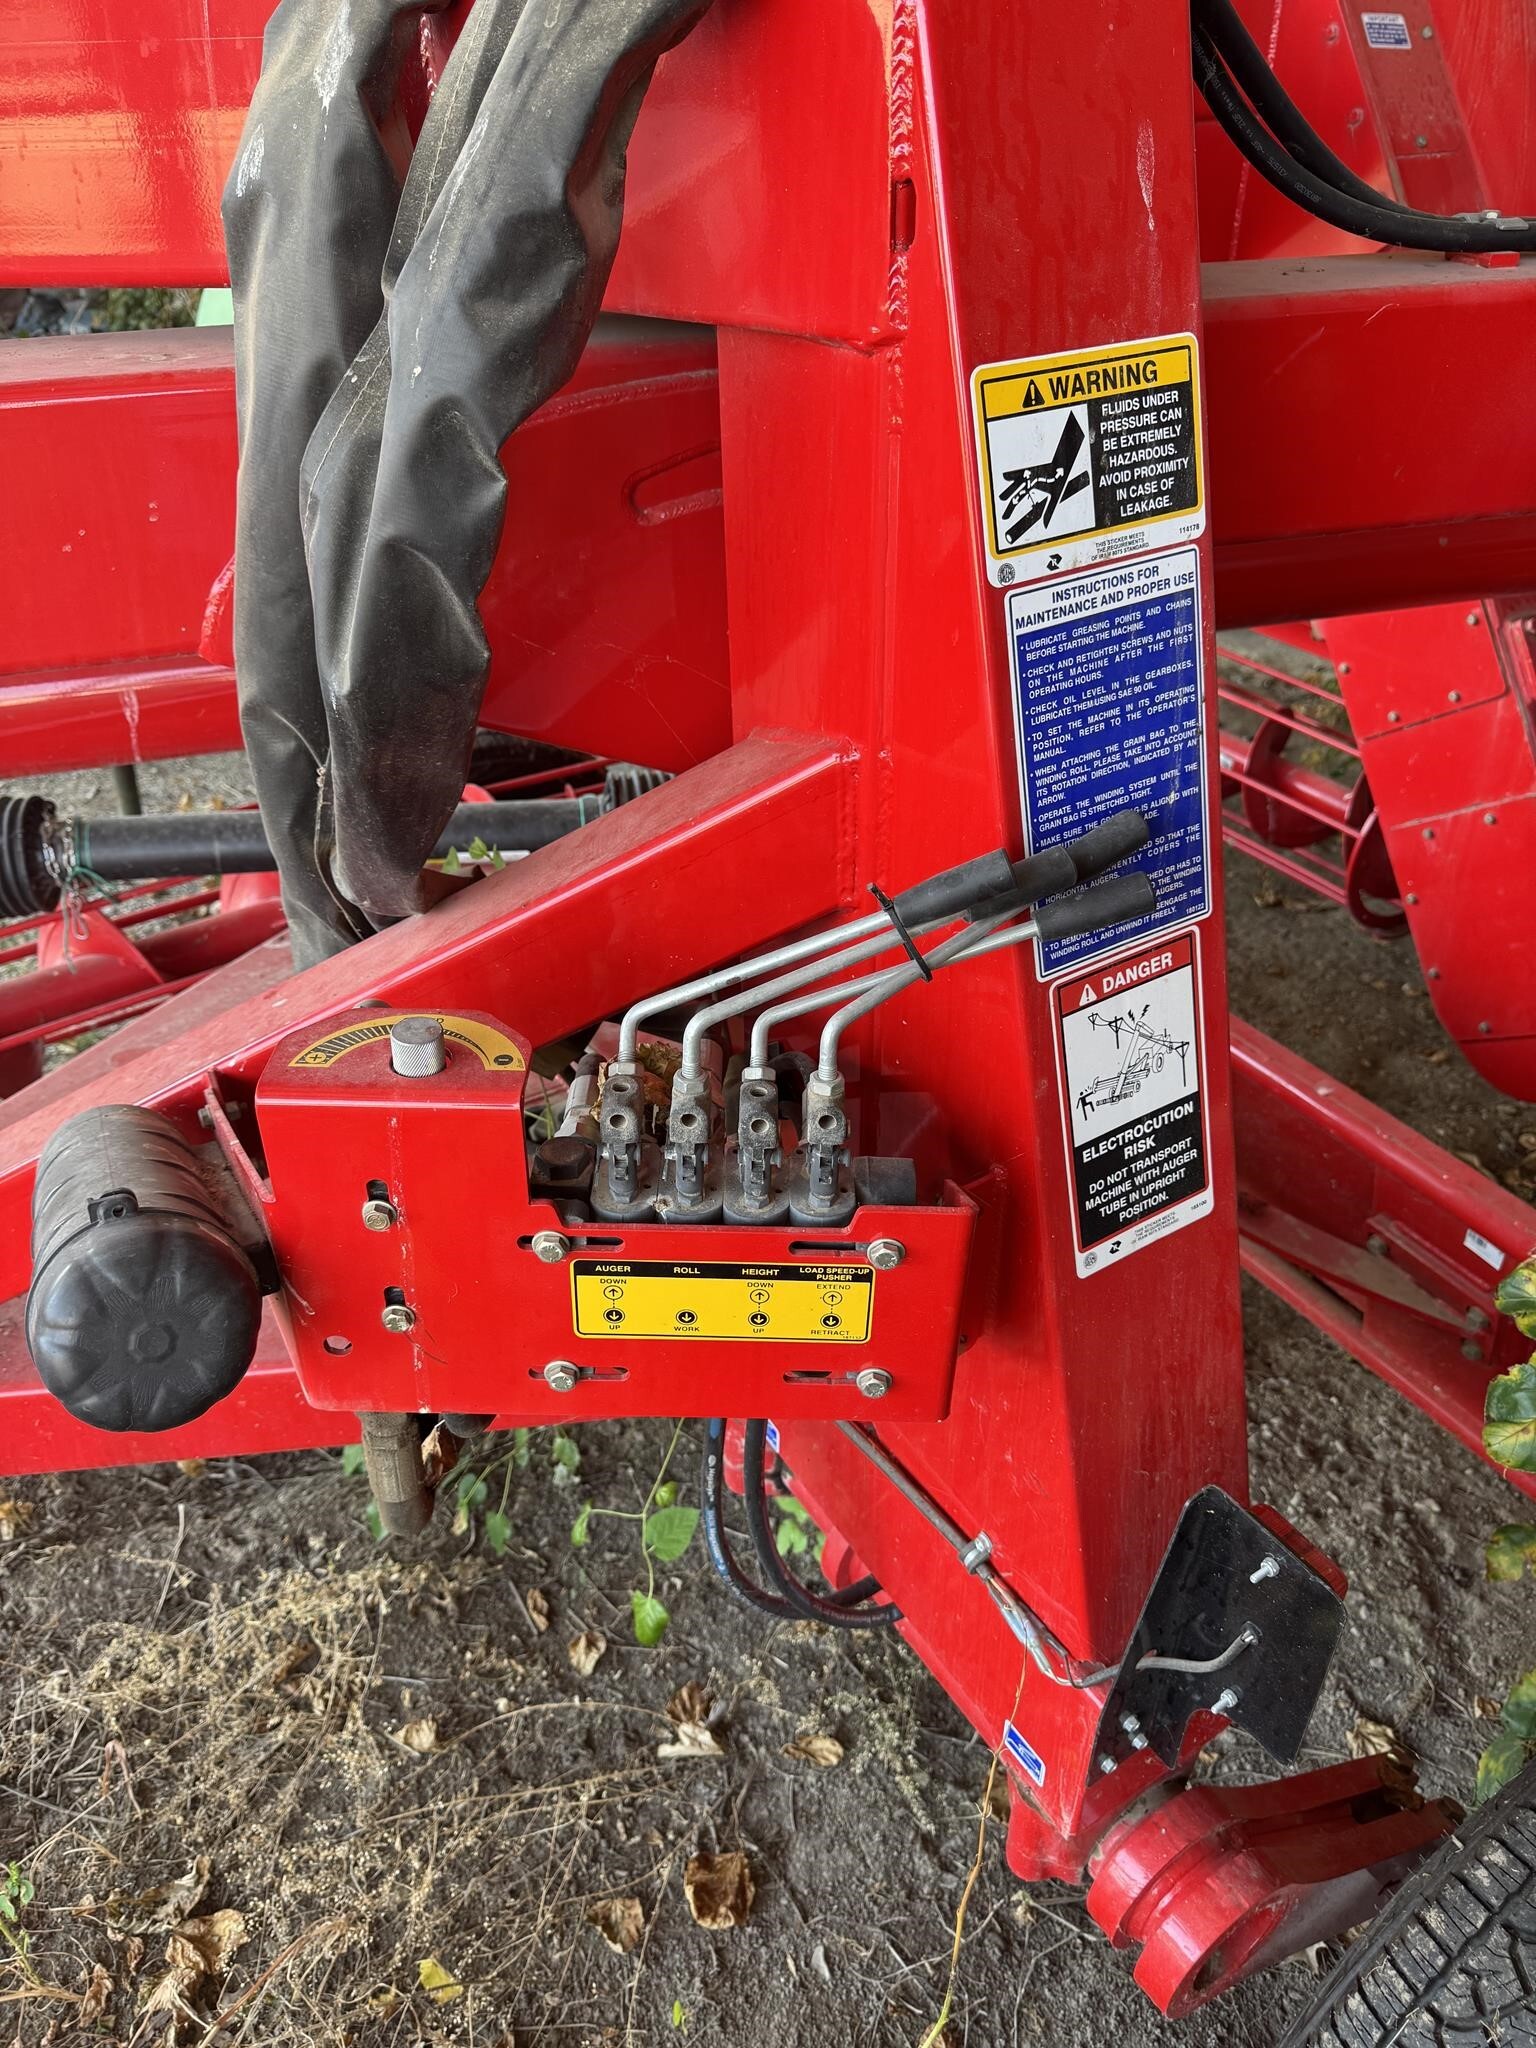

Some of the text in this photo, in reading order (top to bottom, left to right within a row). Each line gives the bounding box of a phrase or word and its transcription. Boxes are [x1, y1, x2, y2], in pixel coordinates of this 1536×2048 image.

[1049, 360, 1158, 401] WARNING
[1102, 391, 1179, 416] FLUIDS UNDER
[1100, 407, 1182, 434] PRESSURE CAN
[1103, 425, 1182, 451] BE EXTREMELY
[1109, 444, 1178, 468] HAZARDOUS.
[1099, 457, 1189, 488] AVOID PROXIMITY
[1116, 478, 1175, 501] IN CASE OF
[1120, 496, 1173, 517] LEAKAGE.
[1129, 532, 1144, 540] MEETS
[1052, 566, 1159, 603] INSTRUCTIONS FOR
[1016, 572, 1194, 630] MAINTENANCE AND PROPER USE
[1025, 598, 1192, 651] LUBRICATE GREASING POINTS AND CHAINS
[1026, 622, 1146, 662] BEFORE STARTING THE MACHINE.
[1027, 624, 1193, 678] CHECK AND RETIGHTEN SCREWS AND NUTS
[1028, 634, 1193, 688] ON THE MACHINE AFTER THE FIRST
[1029, 671, 1104, 699] OPERATING HOURS.
[1030, 660, 1194, 715] CHECK OIL LEVEL IN THE GEARBOXES.
[1031, 682, 1157, 726] LUBRICATE SAE 90 OIL.
[1032, 685, 1195, 741] TO SET THE MACHINE IN ITS OPERATING
[1079, 694, 1196, 737] REFER TO THE OPERATOR'S
[1034, 746, 1066, 762] MANUAL.
[1035, 719, 1197, 777] WHEN ATTACHING THE GRAIN BAG TO THE
[1036, 728, 1196, 788] WINDING PLEASE TAKE INTO ACCOUNT
[1036, 738, 1197, 798] ITS ROTATION INDICATED BY AN
[1038, 792, 1066, 807] ARROW.
[1039, 762, 1198, 822] OPERATE THE WINDING SYSTEM UNTIL THE
[1040, 820, 1062, 832] GRAIN
[1063, 813, 1078, 824] BAG
[1080, 810, 1087, 818] IS
[1088, 795, 1129, 816] STRETCHED
[1130, 788, 1152, 800] TIGHT.
[1040, 834, 1061, 847] MAKE
[1063, 826, 1082, 839] SURE
[1085, 820, 1098, 831] THE
[1182, 786, 1199, 798] WITH
[1148, 840, 1180, 857] COVERS
[1185, 833, 1200, 843] THE
[1155, 823, 1200, 845] SO THAT THE
[1158, 876, 1171, 886] THE
[1173, 865, 1202, 880] WINDING
[1165, 865, 1175, 874] OR
[1177, 860, 1190, 870] HAS
[1045, 884, 1089, 904] HORIZONTAL
[1155, 881, 1184, 896] AUGERS.
[1190, 887, 1203, 897] THE
[1049, 942, 1059, 951] TO
[1050, 943, 1080, 960] WINDING
[1081, 936, 1099, 949] ROLL
[1101, 930, 1114, 941] AND
[1116, 919, 1142, 934] UNWIND
[1144, 916, 1150, 924] IT
[1151, 906, 1176, 920] FREELY.
[1103, 952, 1172, 994] DANGER
[1082, 1101, 1194, 1163] ELECTROCUTION
[1124, 1136, 1156, 1160] RISK
[1086, 1149, 1197, 1211] MACHINE WITH AUGER
[1089, 1137, 1192, 1194] DO NOT TRANSPORT
[1099, 1168, 1187, 1218] TUBE IN UPRIGHT
[1119, 1191, 1169, 1222] POSITION.
[595, 1265, 631, 1273] AUGER
[742, 1268, 780, 1276] HEIGHT
[826, 1267, 870, 1275] SPEED-UP
